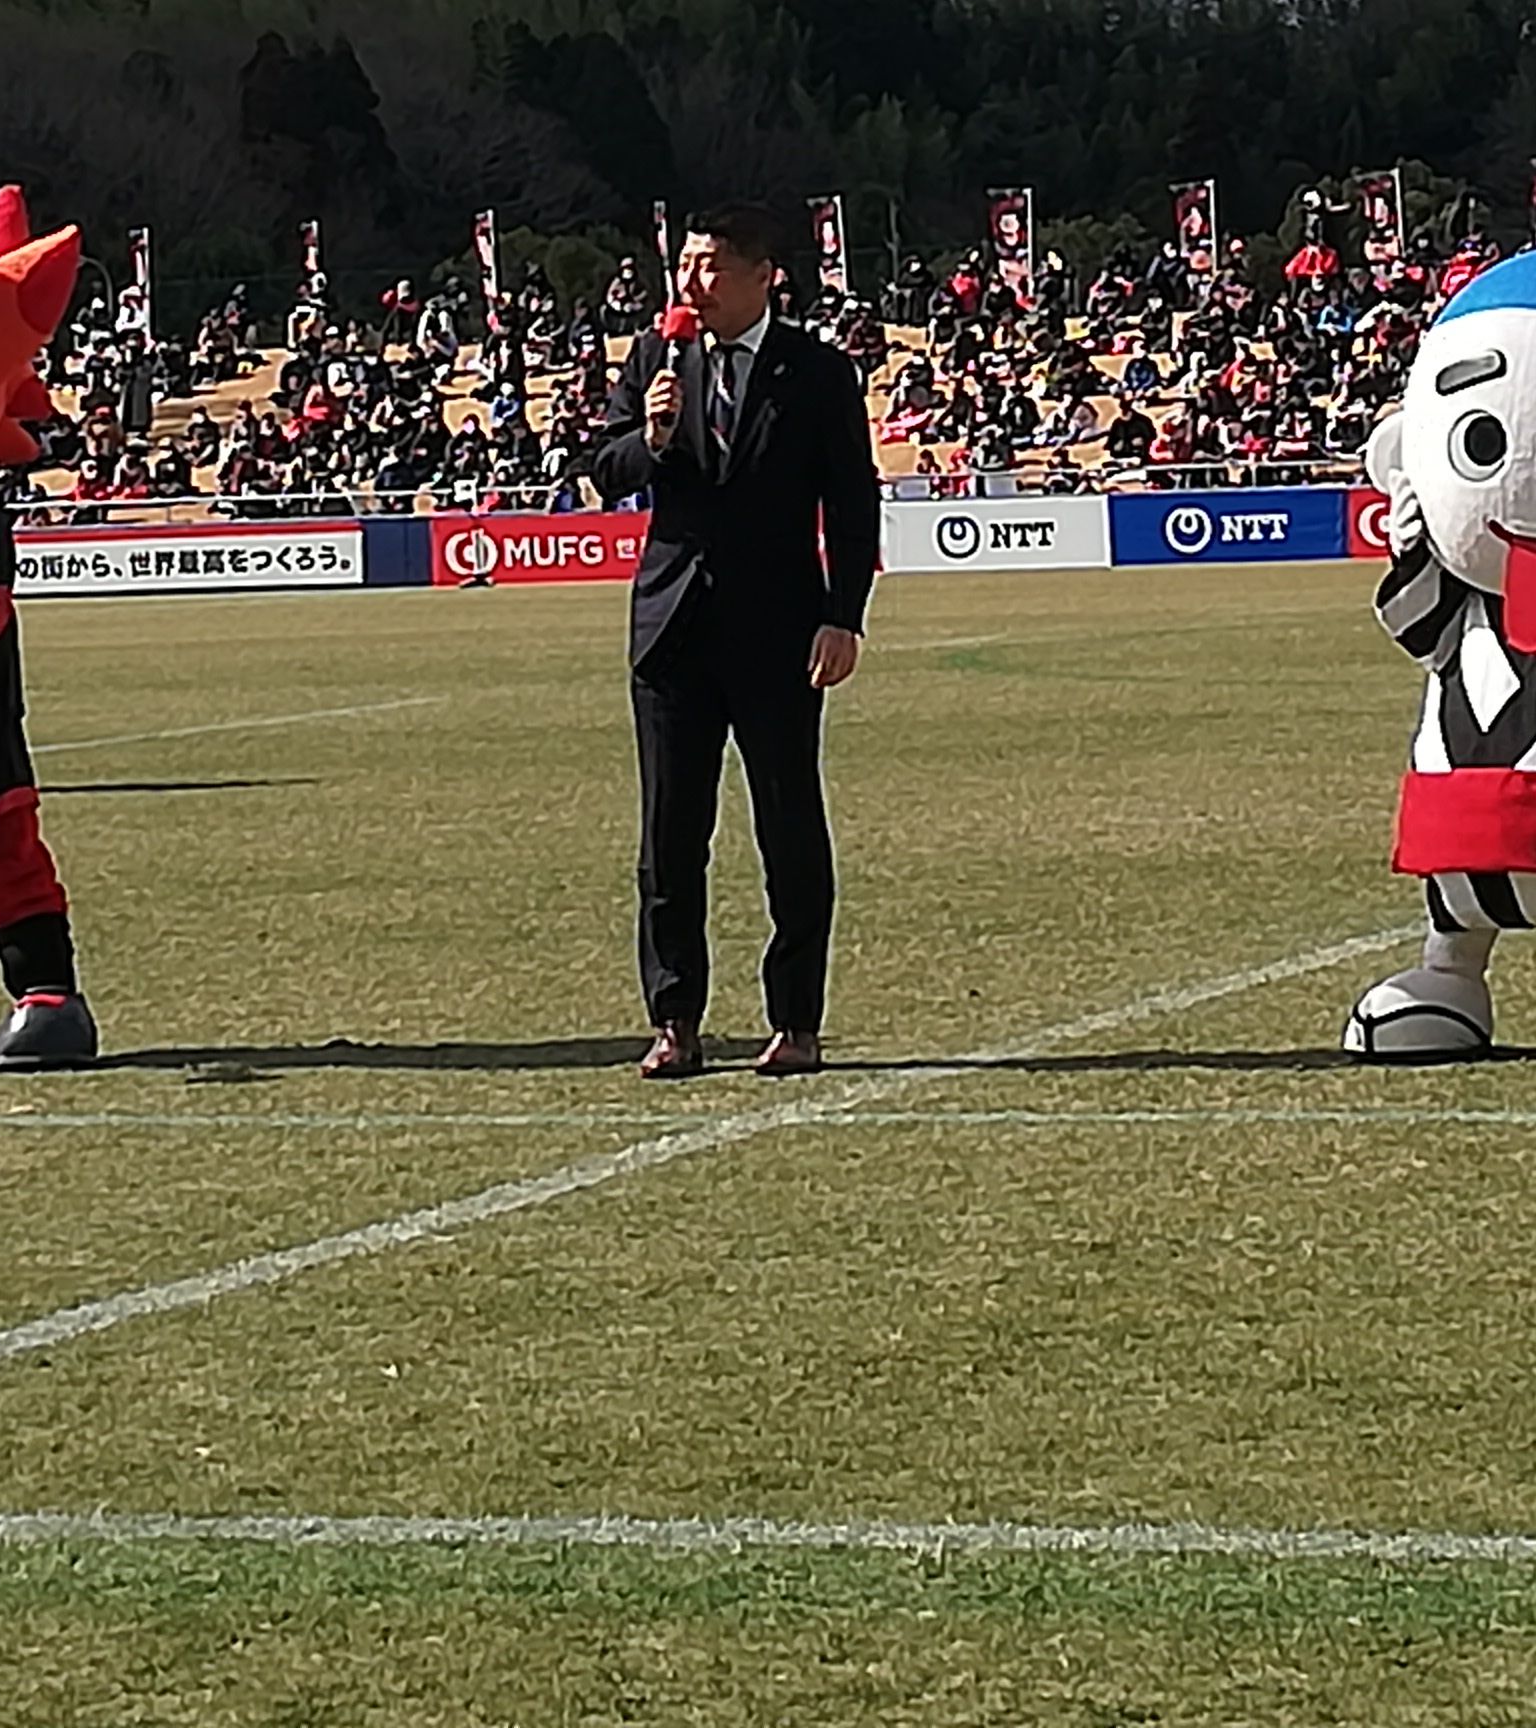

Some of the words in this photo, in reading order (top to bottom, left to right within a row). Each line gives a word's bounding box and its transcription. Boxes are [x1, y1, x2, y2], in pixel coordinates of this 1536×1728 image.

[989, 521, 1055, 549] NTT
[1221, 513, 1289, 542] NTT
[502, 534, 605, 568] MUFG
